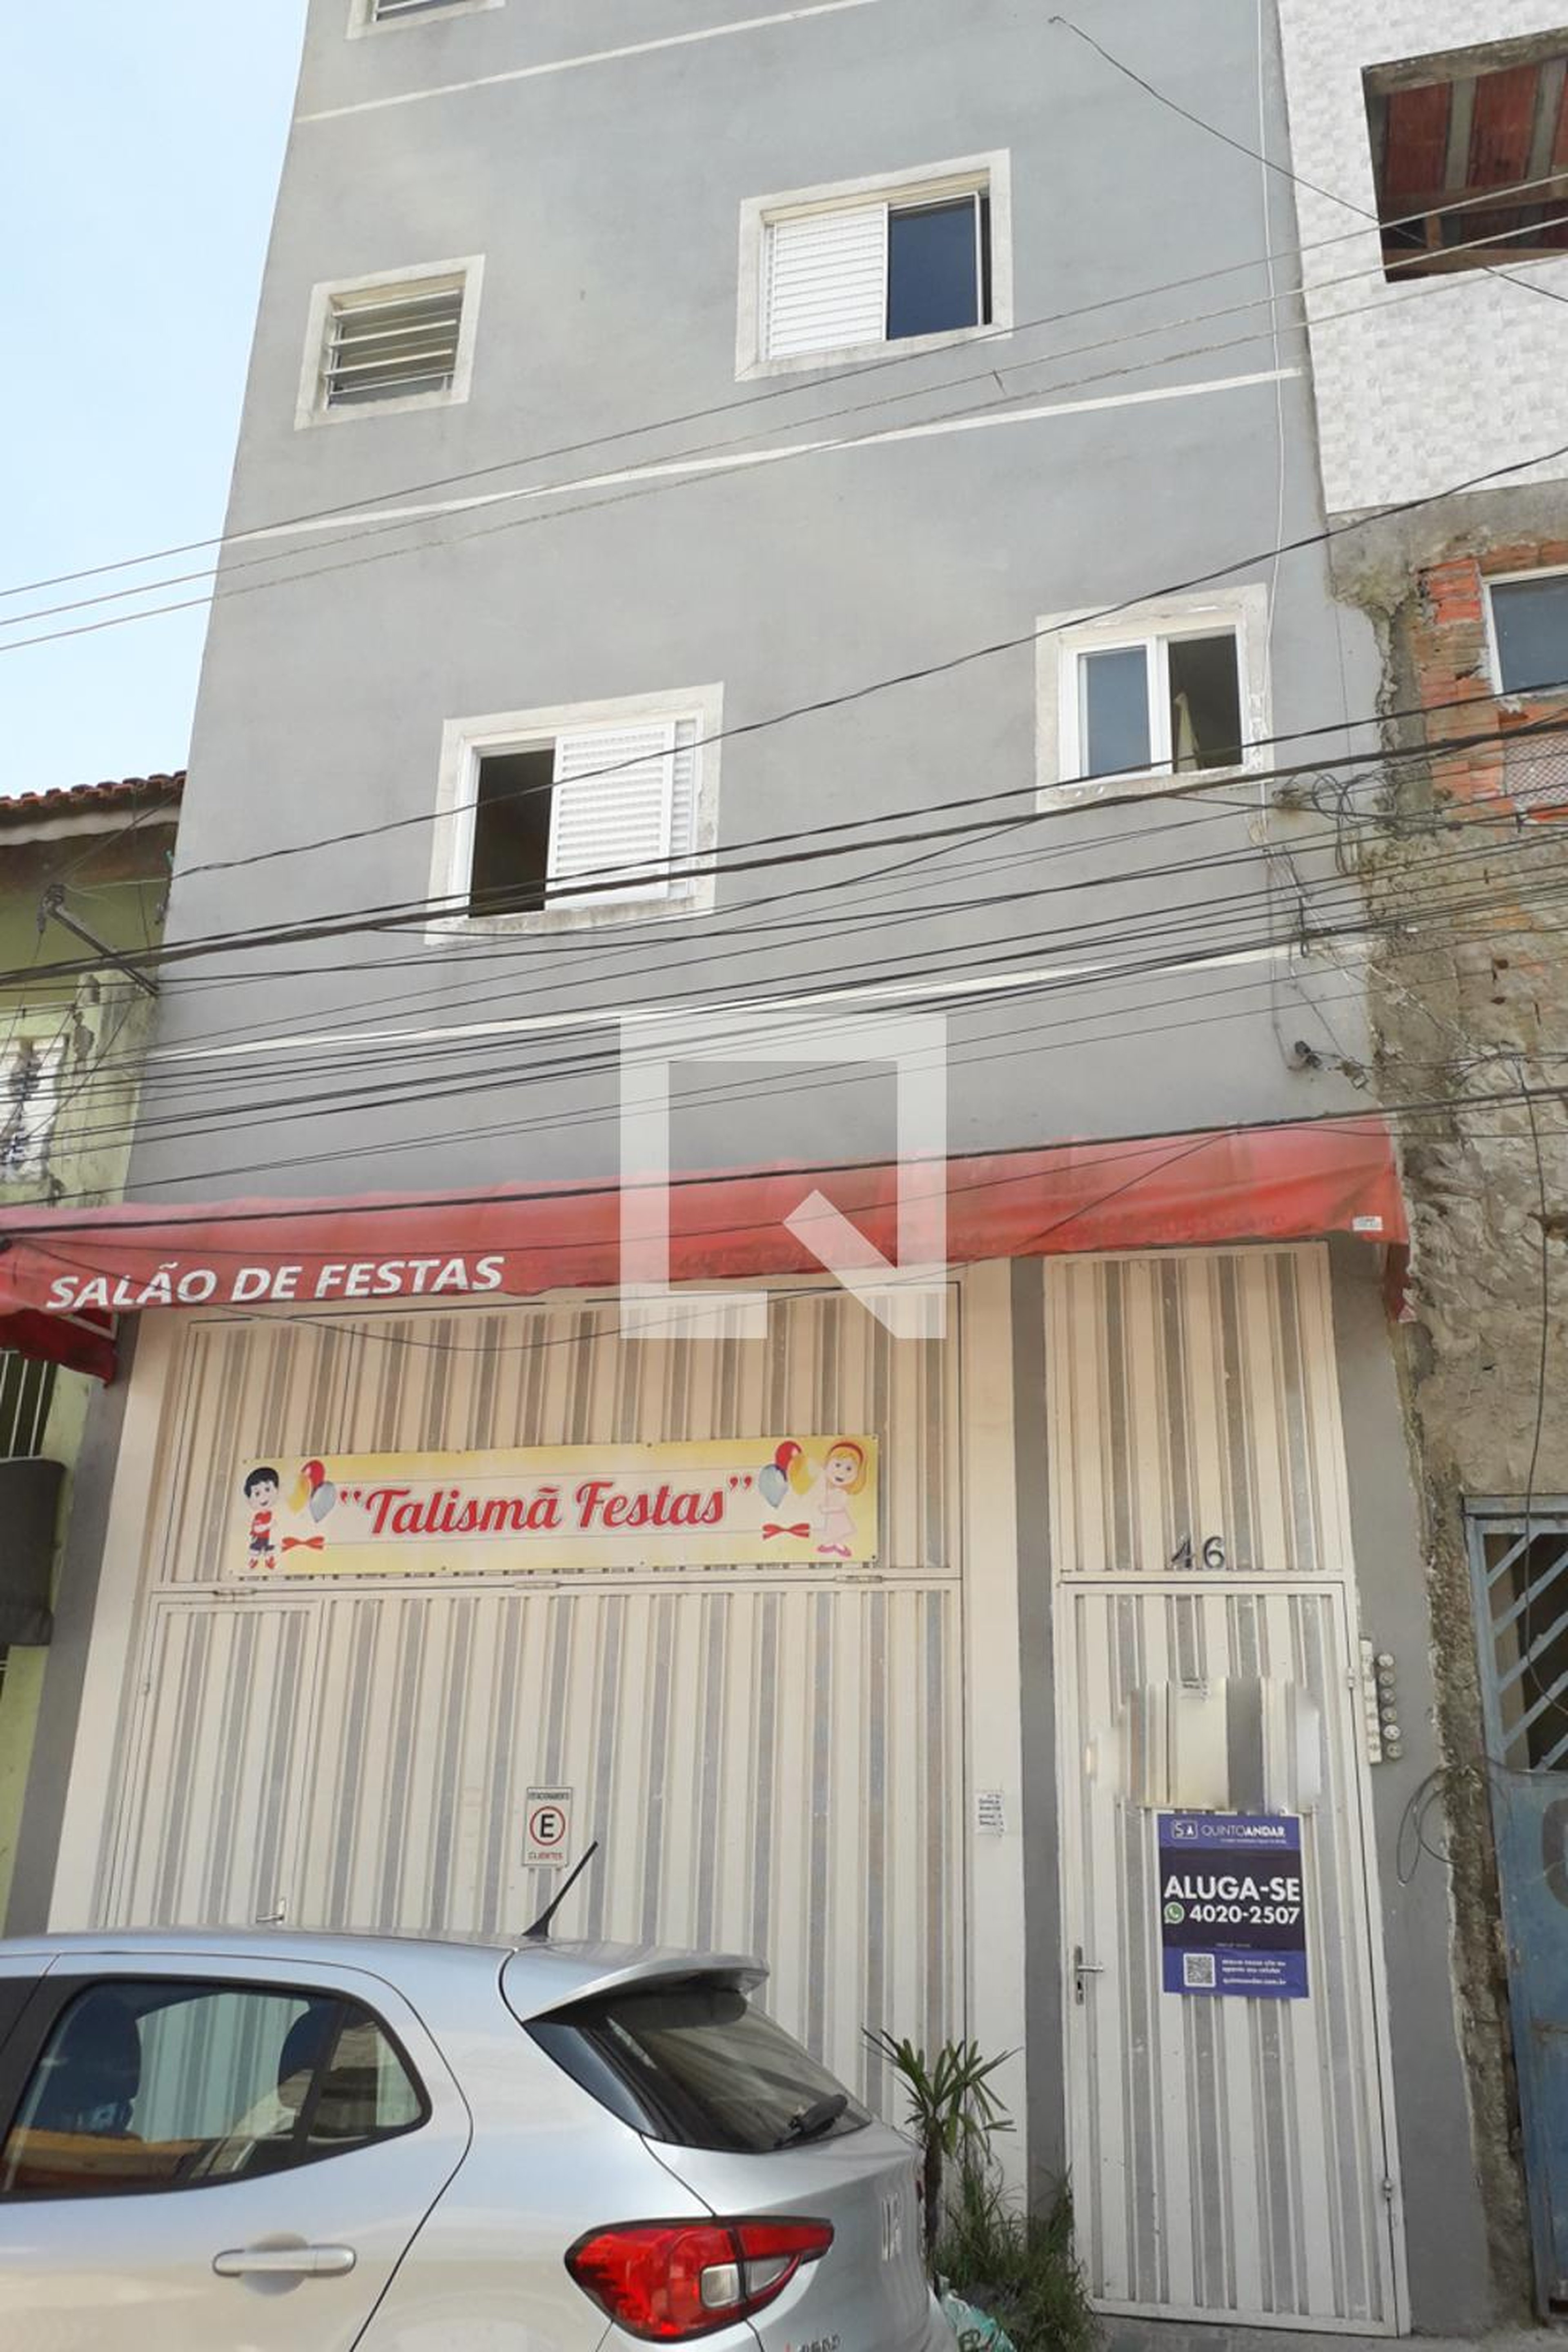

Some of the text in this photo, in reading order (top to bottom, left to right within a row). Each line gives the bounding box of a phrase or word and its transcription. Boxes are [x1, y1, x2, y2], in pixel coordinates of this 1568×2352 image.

[46, 1256, 505, 1309] SALÃO DE FESTAS
[1171, 1536, 1225, 1568] 46
[540, 1813, 555, 1838] E
[1164, 1875, 1300, 1901] ALUGA-SE
[1189, 1905, 1300, 1924] 4020-2507
